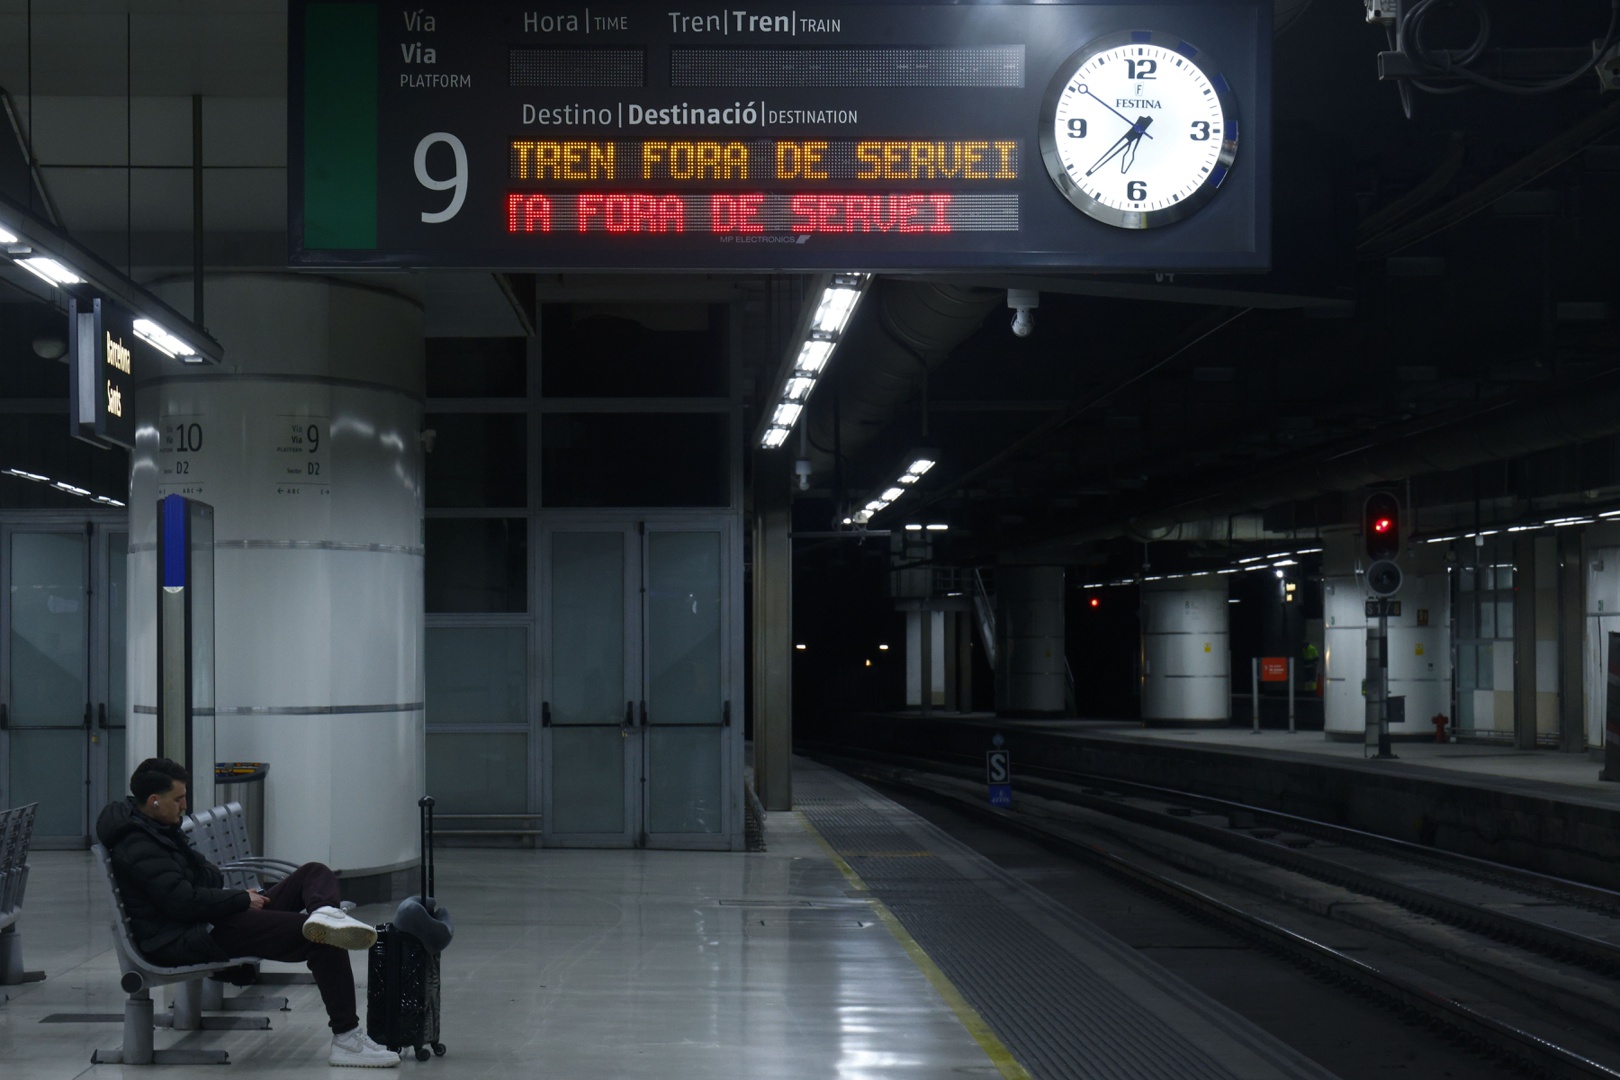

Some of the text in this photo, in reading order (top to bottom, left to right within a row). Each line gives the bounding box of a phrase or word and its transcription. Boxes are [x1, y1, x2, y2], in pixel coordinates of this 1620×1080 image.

[403, 9, 436, 32] Vía
[523, 11, 628, 33] Hora TIME
[668, 11, 841, 33] Tren Tren TRAIN
[400, 43, 437, 65] Via
[1123, 58, 1158, 80] 12
[400, 73, 472, 89] PLATFORM
[522, 101, 858, 126] Destino Destinació DESTINATION
[1115, 98, 1162, 110] FESTINA
[1066, 118, 1088, 140] 9
[1189, 120, 1211, 142] 3
[513, 140, 1017, 180] TREN FORA DE SERVEI
[413, 131, 469, 224] 9
[1126, 180, 1148, 202] 6
[577, 193, 685, 233] FORA
[710, 193, 764, 233] DE
[790, 193, 952, 233] SERVEI
[719, 235, 796, 244] MP ELECTRONICS
[106, 329, 131, 376] Barcelona
[106, 378, 122, 418] Sants
[175, 422, 204, 453] 10
[306, 423, 320, 454] 9
[176, 460, 190, 475] D2
[307, 461, 321, 476] D2
[990, 753, 1006, 781] S
